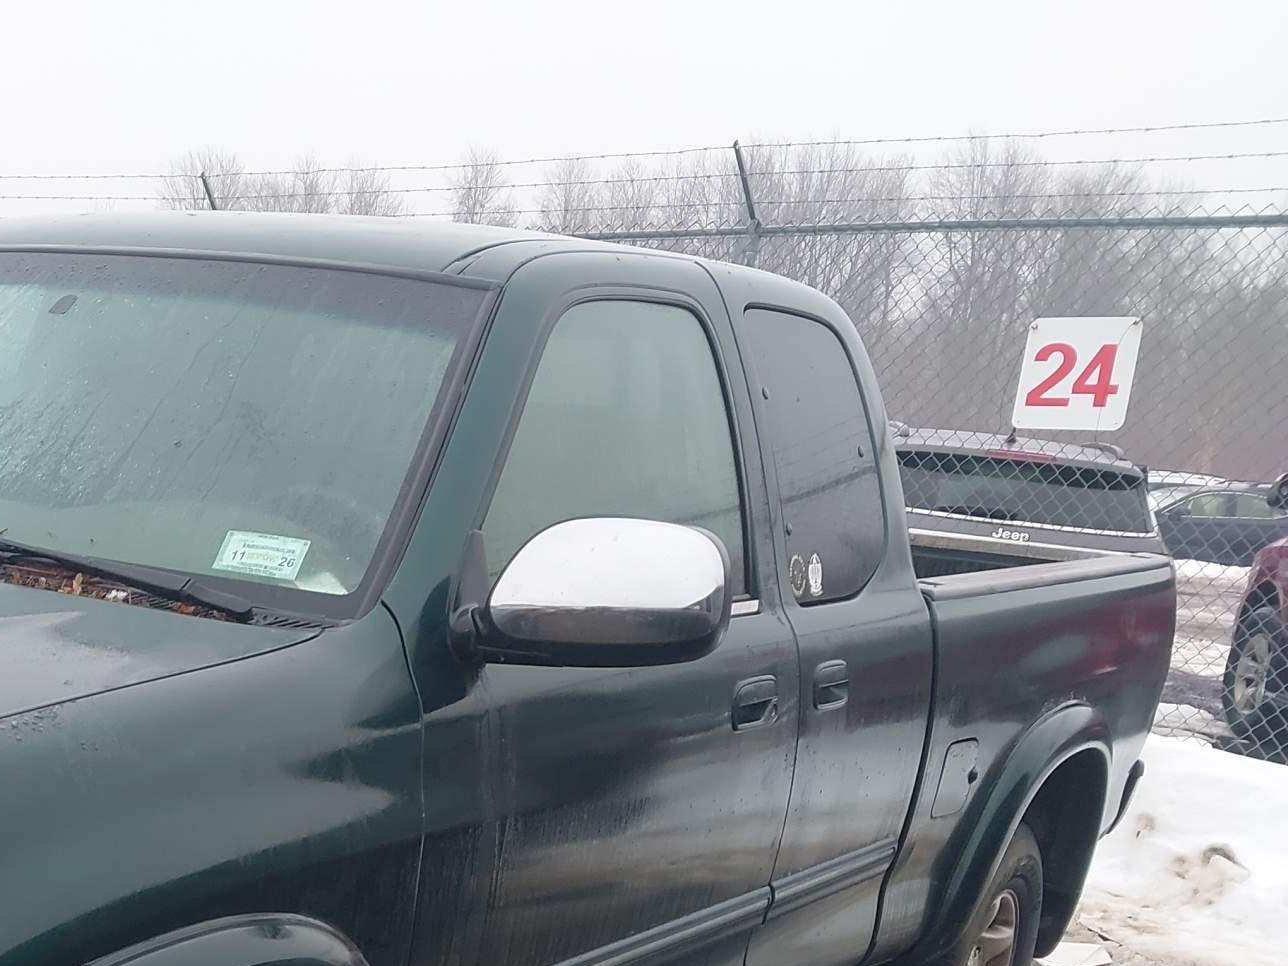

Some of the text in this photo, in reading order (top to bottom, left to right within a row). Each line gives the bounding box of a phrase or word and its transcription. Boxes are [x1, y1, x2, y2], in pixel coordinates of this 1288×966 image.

[1024, 342, 1120, 408] 24
[991, 527, 1030, 542] Jeep
[231, 550, 296, 568] 11 26
